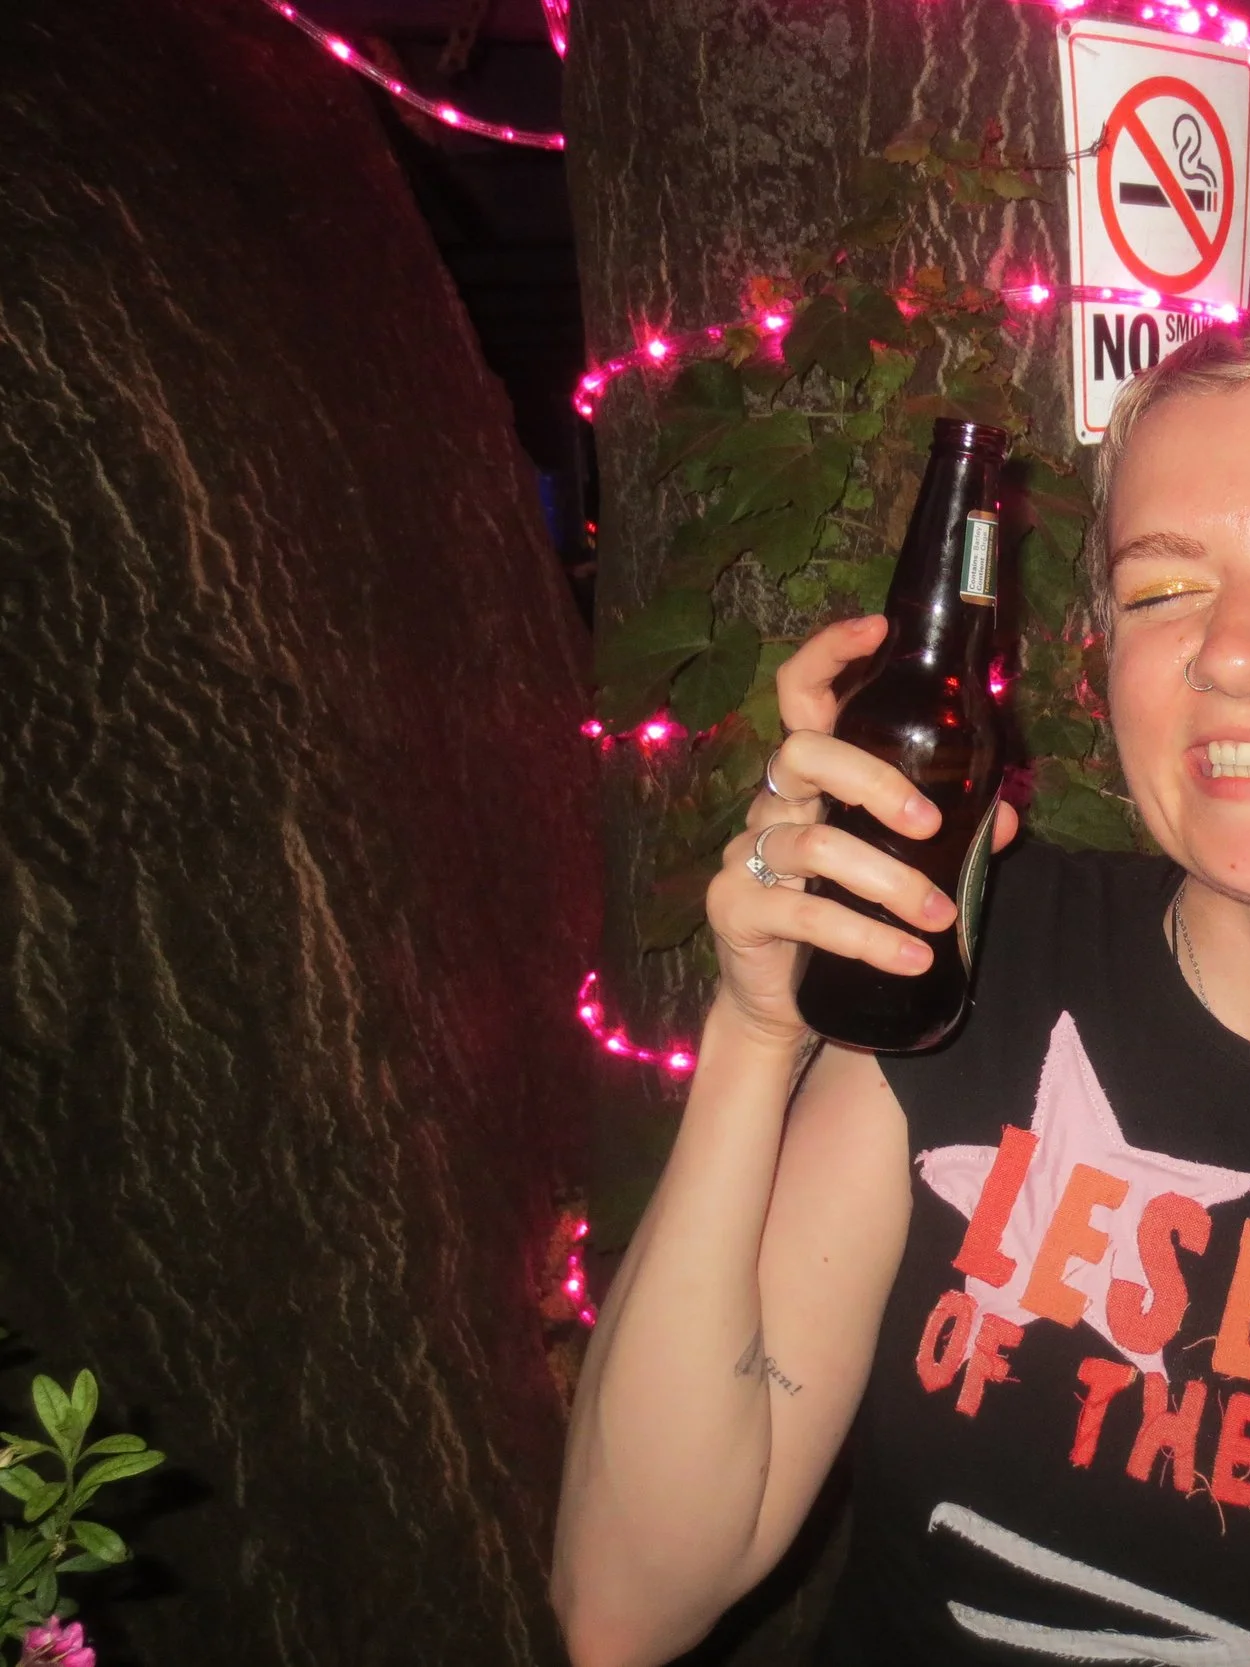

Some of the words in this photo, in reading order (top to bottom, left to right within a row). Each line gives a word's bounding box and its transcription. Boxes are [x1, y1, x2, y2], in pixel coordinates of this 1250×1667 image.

[1093, 313, 1160, 380] NO
[1166, 313, 1211, 342] SMOK
[916, 1291, 1024, 1417] OF
